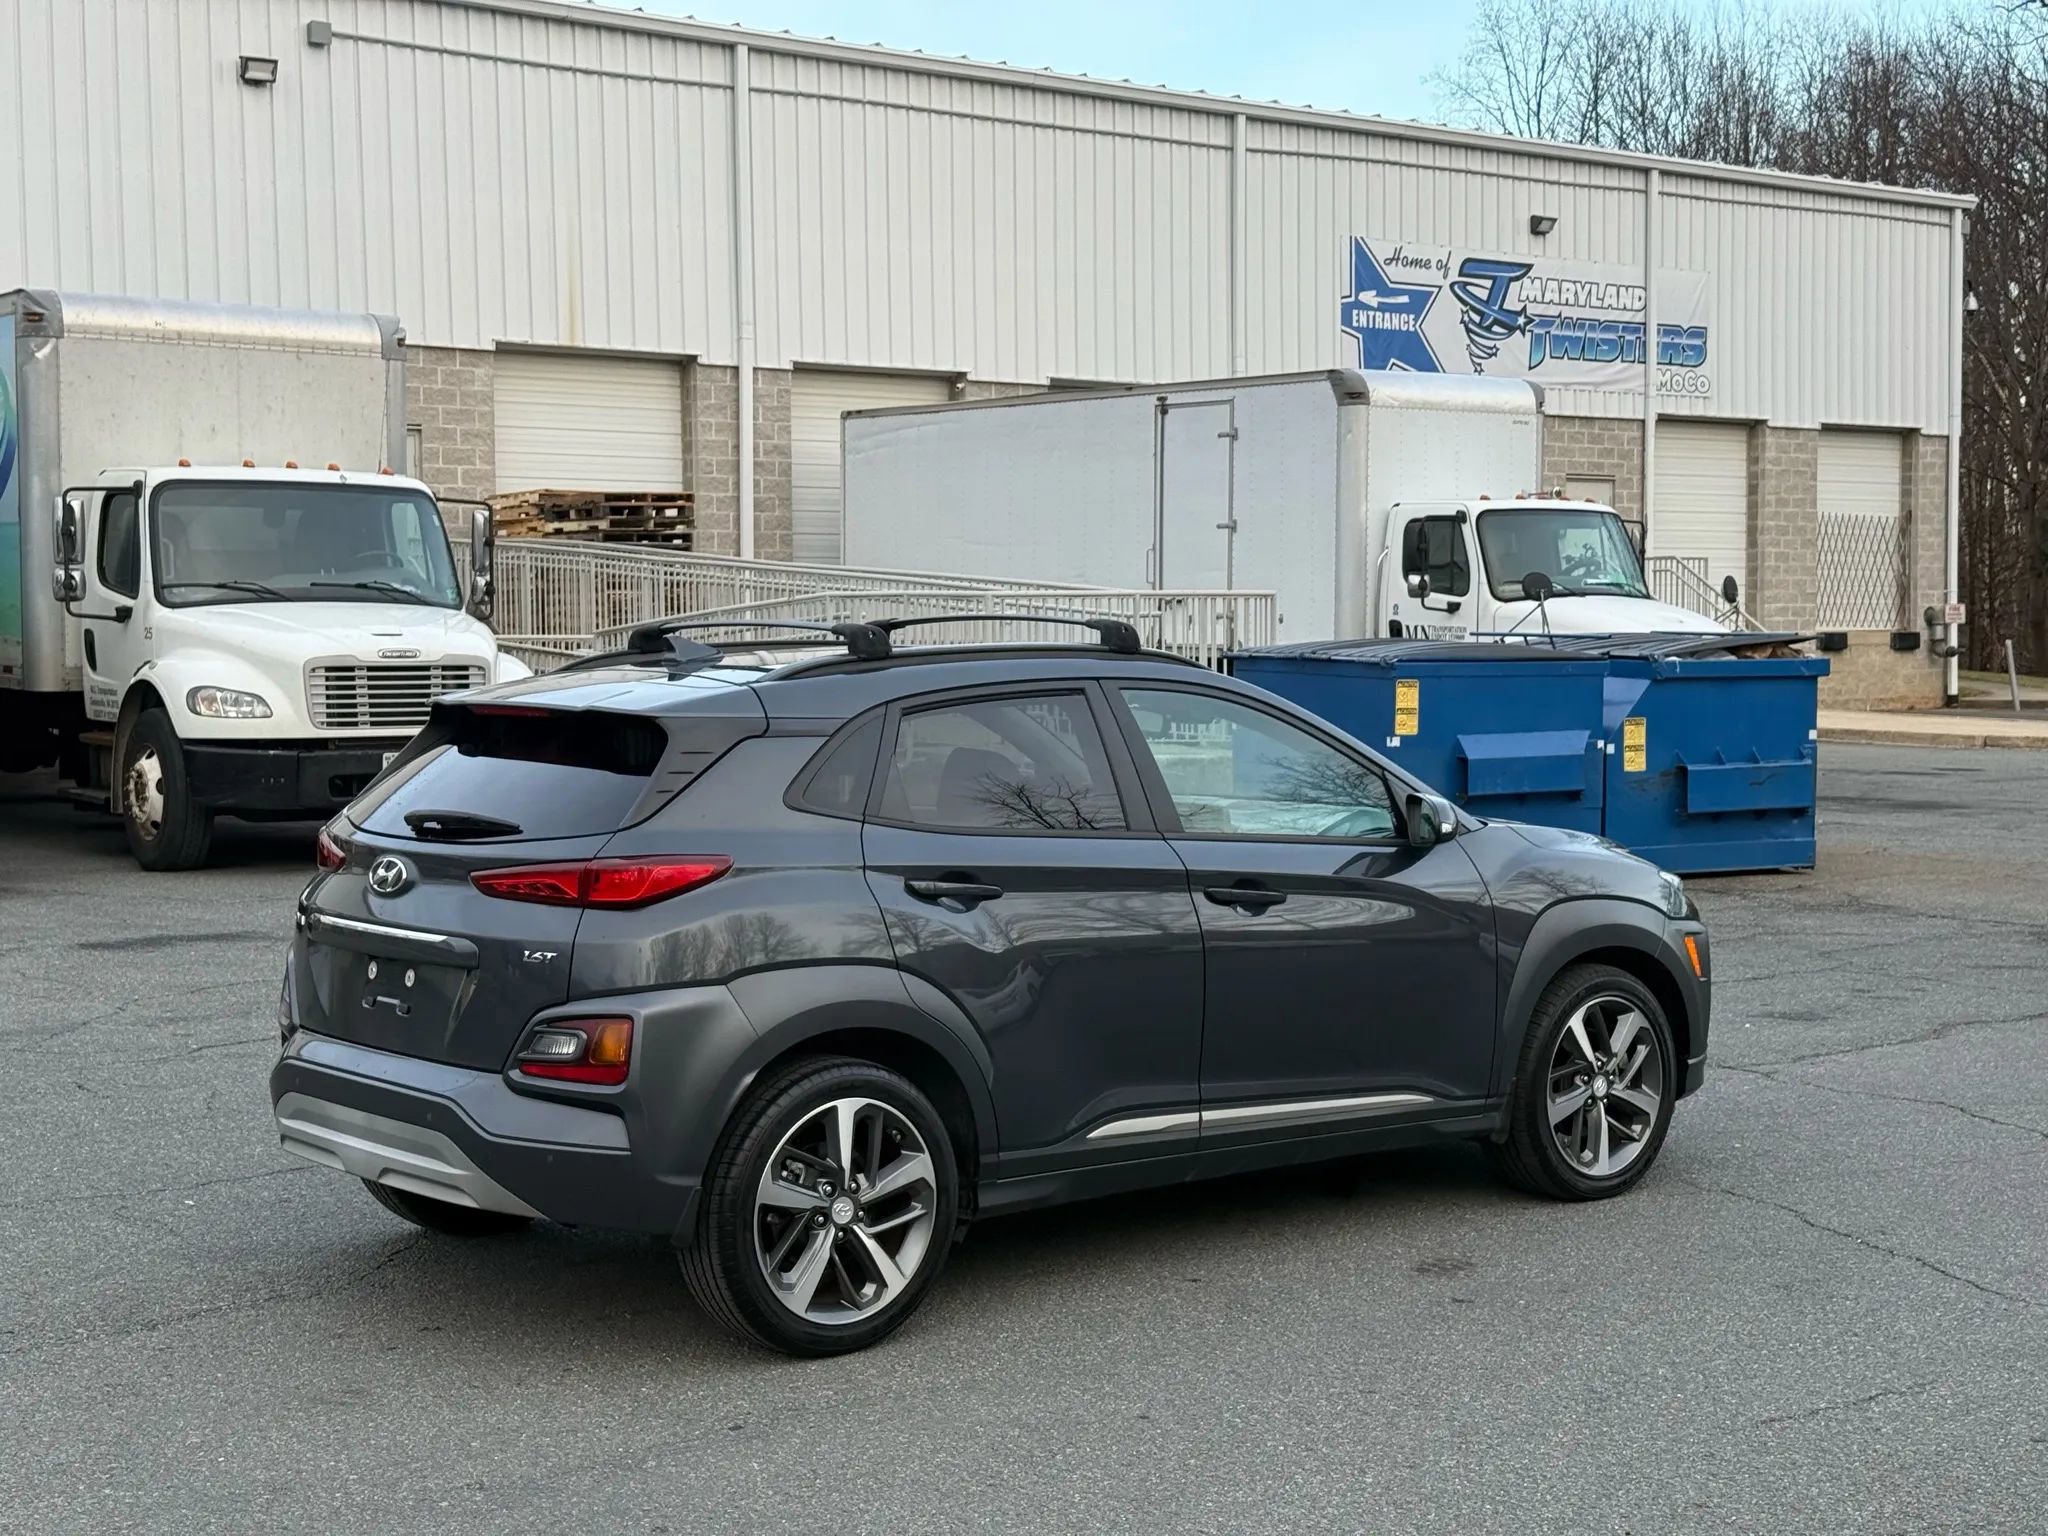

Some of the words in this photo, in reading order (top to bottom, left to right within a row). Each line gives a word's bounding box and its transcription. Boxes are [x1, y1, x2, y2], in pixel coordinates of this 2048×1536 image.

[1384, 246, 1432, 270] Home
[1436, 250, 1452, 280] of
[1519, 276, 1647, 312] MARYLAND
[1352, 309, 1416, 332] ENTRANCE
[144, 626, 153, 640] 25
[1404, 624, 1431, 640] MN
